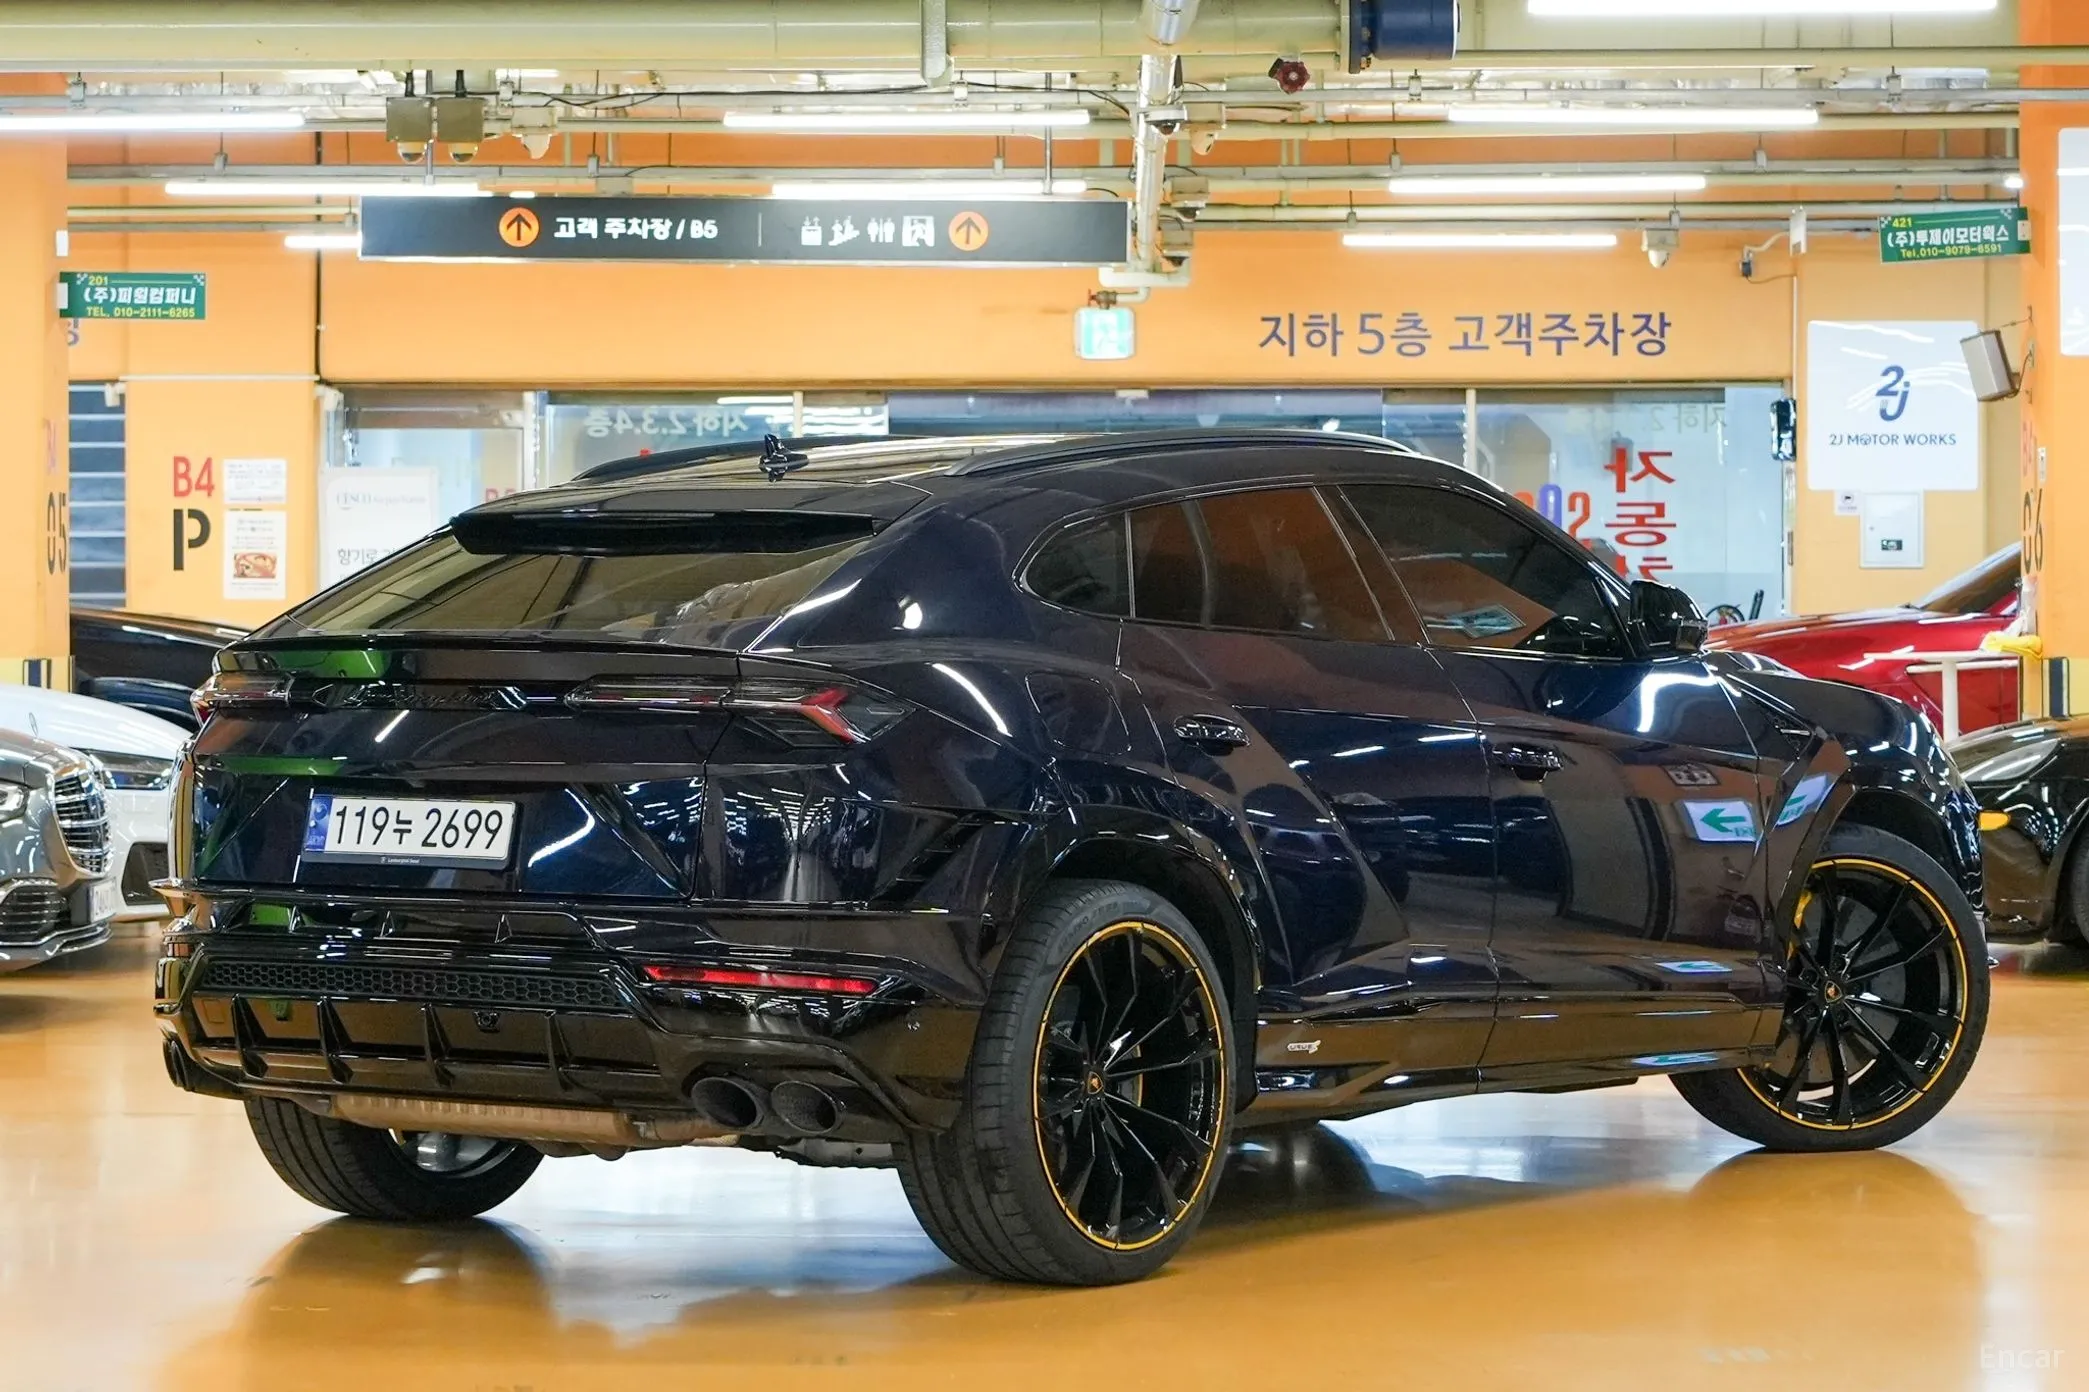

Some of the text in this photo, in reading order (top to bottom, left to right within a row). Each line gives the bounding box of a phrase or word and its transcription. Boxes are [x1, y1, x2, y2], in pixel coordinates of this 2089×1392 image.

[554, 217, 598, 239] 고객
[604, 216, 673, 240] 주차장
[690, 219, 718, 239] B5
[1892, 217, 1912, 228] 421
[88, 275, 108, 286] 201
[114, 307, 195, 318] 010-2111-6265
[1258, 312, 1672, 357] 지하 5층 고객주차장
[1829, 433, 1957, 446] 2J MOTOR WORKS
[173, 455, 215, 497] B4
[173, 508, 212, 571] P
[335, 805, 504, 850] 119누 2699
